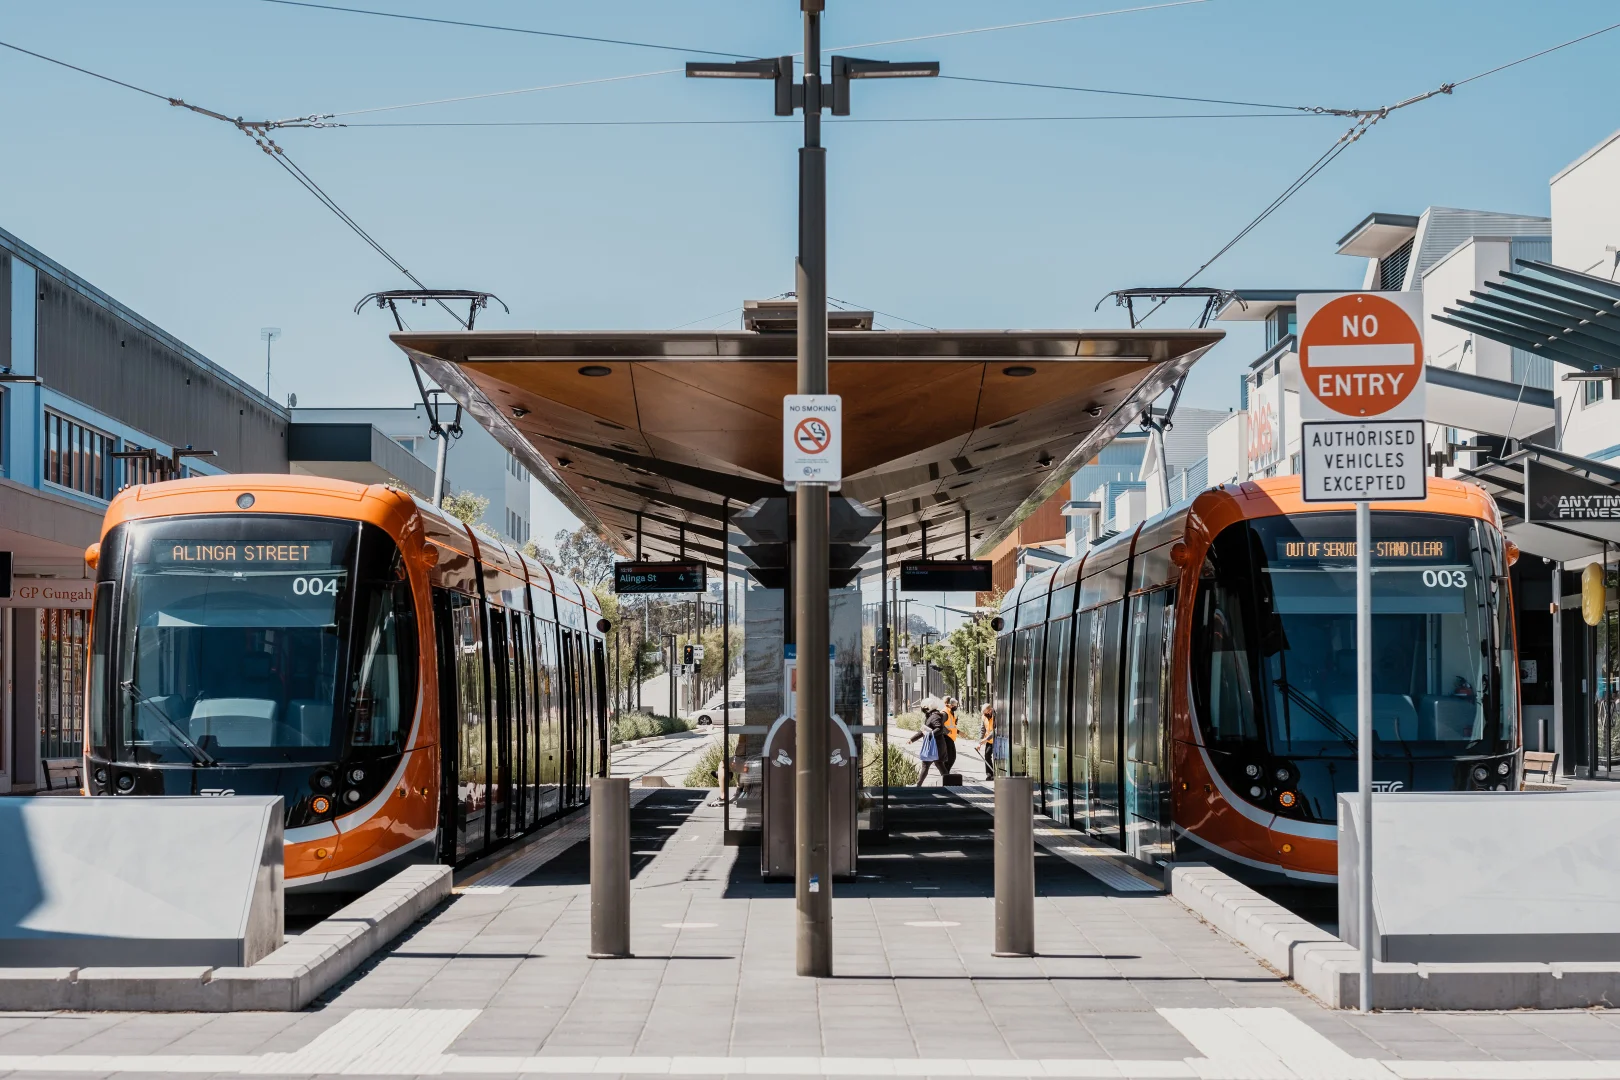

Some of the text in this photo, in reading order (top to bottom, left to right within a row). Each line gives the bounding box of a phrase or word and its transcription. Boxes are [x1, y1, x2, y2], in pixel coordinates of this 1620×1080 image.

[1342, 314, 1378, 338] NO
[1318, 372, 1405, 397] ENTRY
[1312, 430, 1415, 447] AUTHORISED
[1324, 452, 1404, 469] VEHICLES
[1323, 475, 1406, 492] EXCEPTED
[173, 545, 310, 561] ALINGA STREET
[1286, 542, 1305, 557] OUT
[1307, 542, 1320, 557] OF
[1323, 542, 1358, 557] SERVIC
[1376, 542, 1409, 557] STAND
[1411, 541, 1443, 556] CLEAR
[292, 577, 339, 596] 004
[620, 574, 646, 584] Alinga
[647, 574, 657, 582] St
[678, 574, 684, 582] 4
[1422, 570, 1468, 588] 003
[20, 587, 39, 599] GP
[42, 587, 94, 603] Gungah
